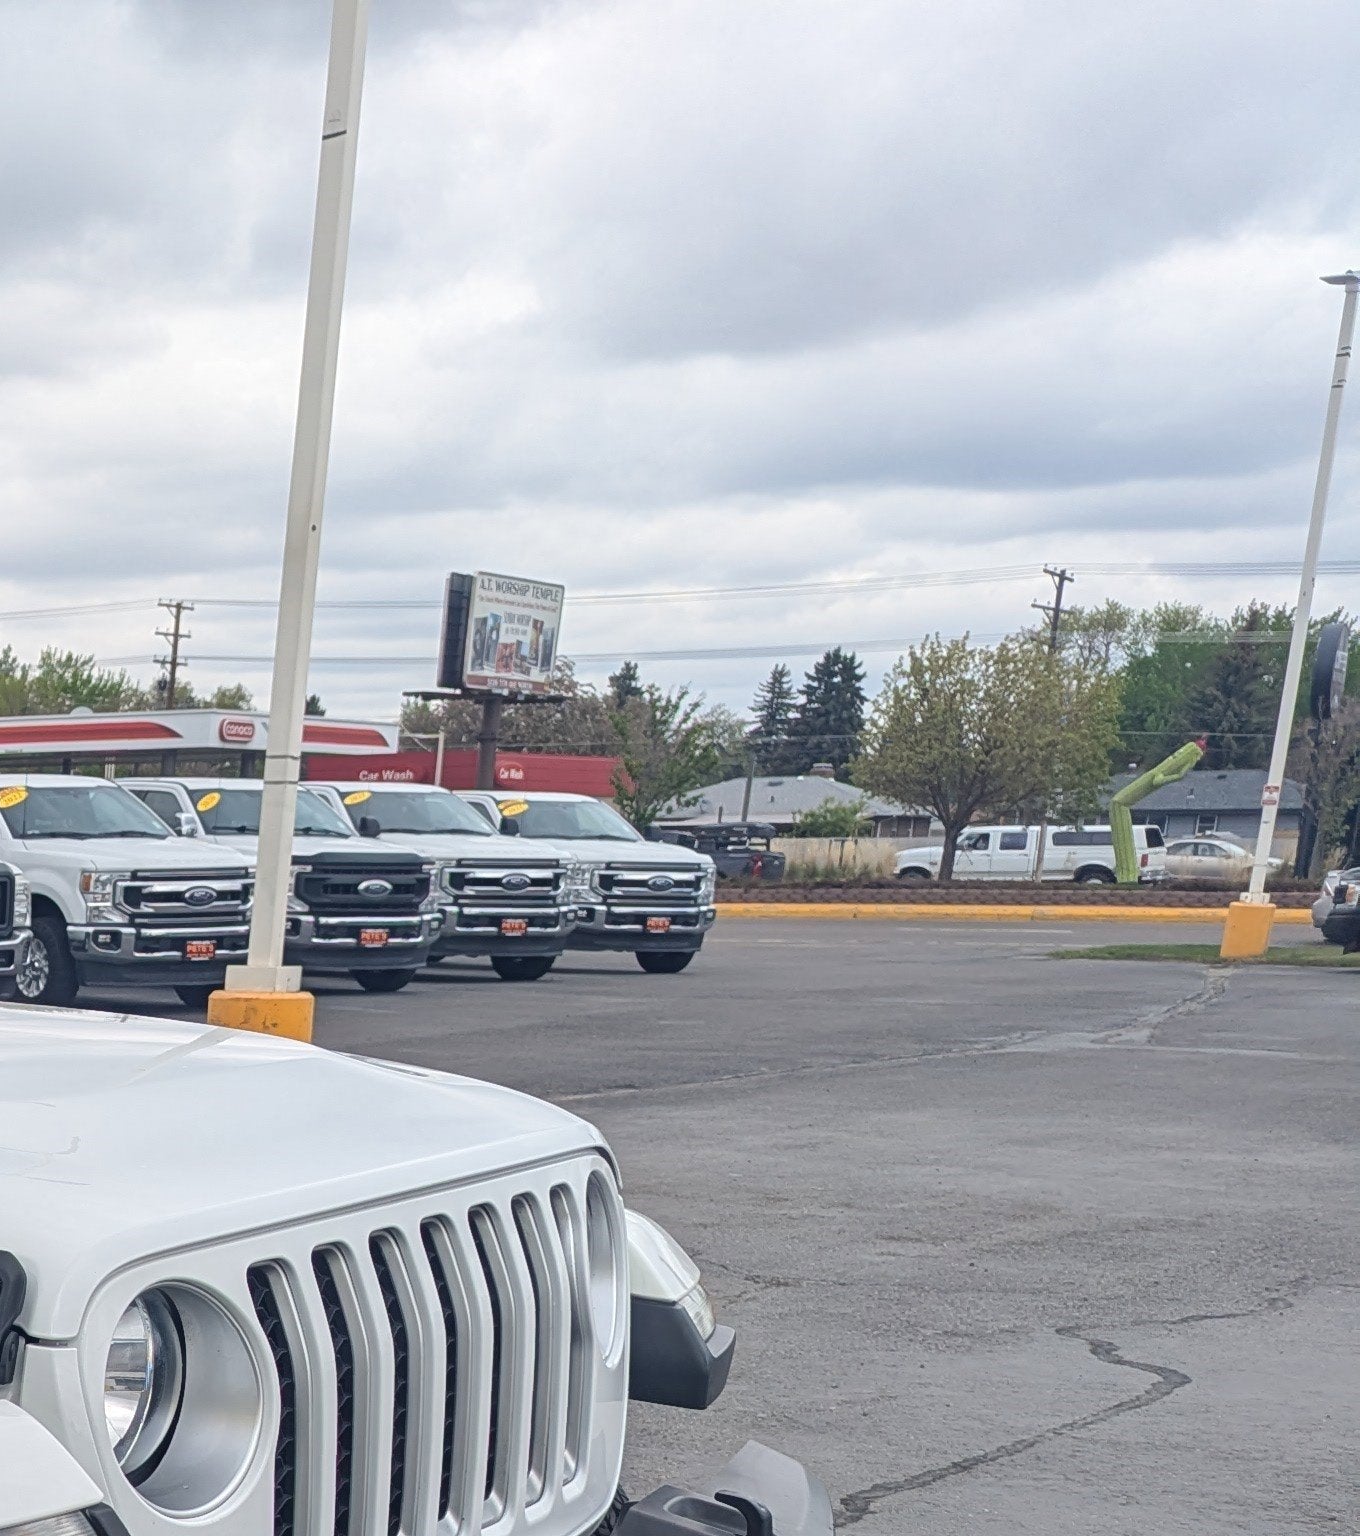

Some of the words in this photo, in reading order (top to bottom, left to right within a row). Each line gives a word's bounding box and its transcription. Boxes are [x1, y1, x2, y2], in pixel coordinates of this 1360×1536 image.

[496, 580, 530, 596] WORSHIP
[532, 586, 559, 602] TEMPLE
[359, 770, 379, 781] Car
[382, 769, 414, 781] Wash
[499, 768, 509, 780] Car
